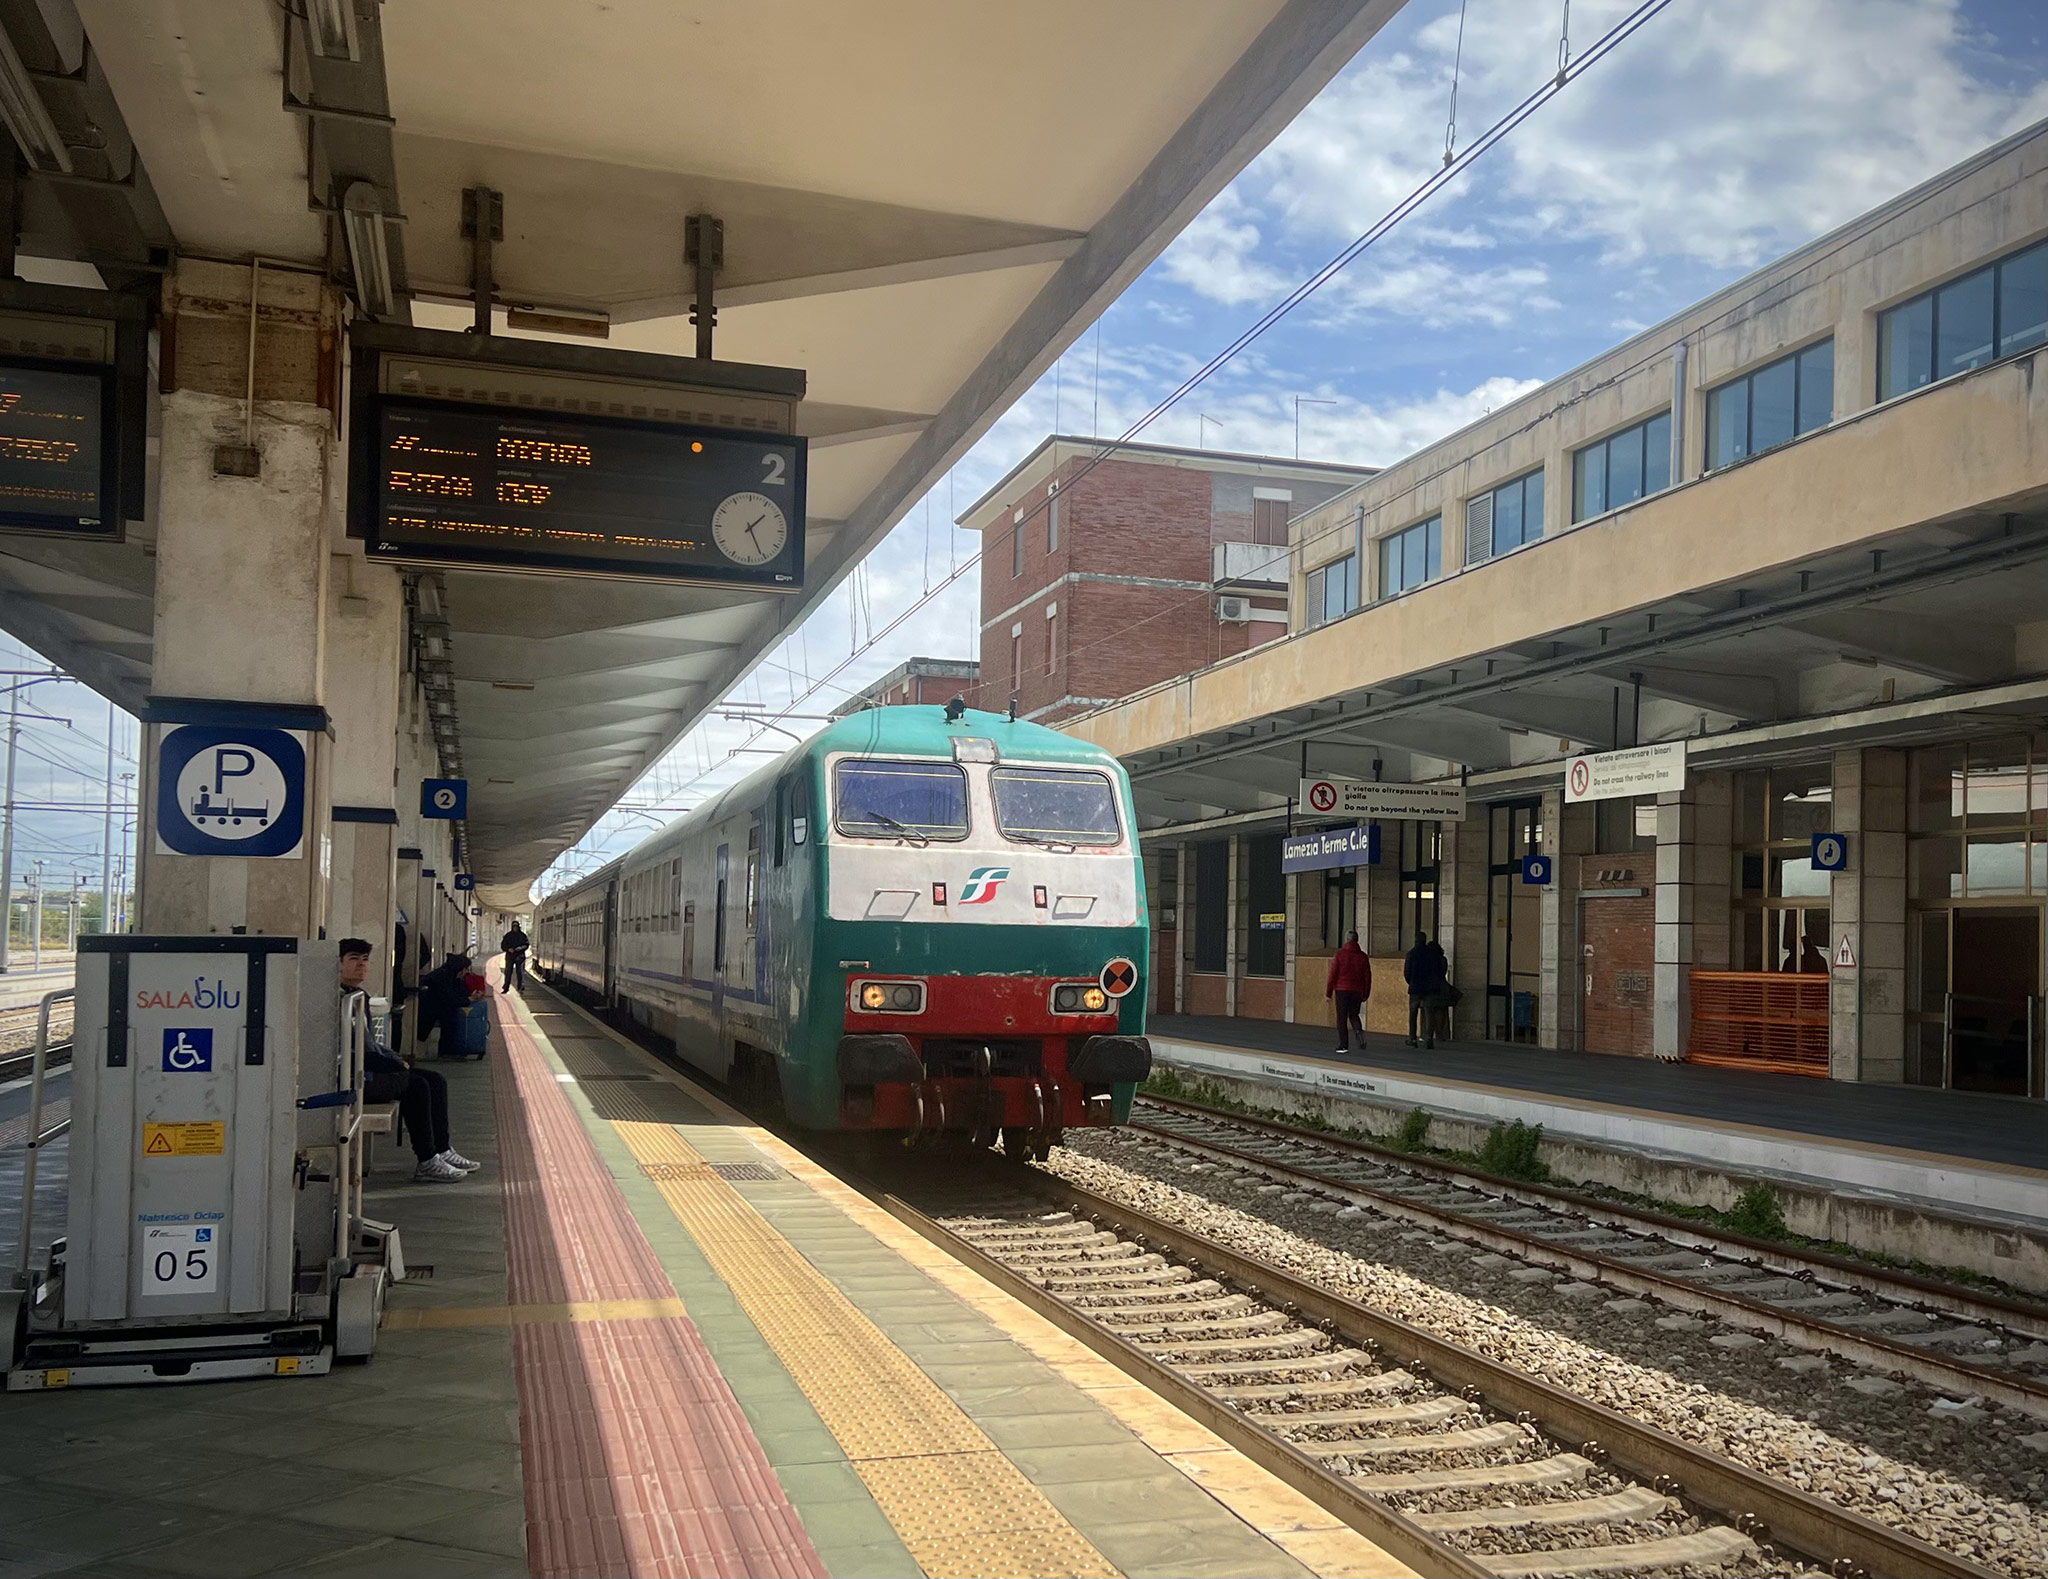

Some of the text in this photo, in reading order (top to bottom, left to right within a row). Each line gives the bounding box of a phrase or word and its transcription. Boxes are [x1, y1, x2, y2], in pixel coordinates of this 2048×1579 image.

[761, 452, 786, 486] 2
[214, 748, 255, 794] P
[1593, 778, 1601, 786] Do
[1602, 777, 1611, 785] not
[1624, 774, 1634, 782] the
[1634, 772, 1655, 781] railway
[1352, 785, 1380, 793] vietato
[1381, 786, 1429, 796] oltrepassare
[1440, 789, 1459, 797] linea
[440, 792, 450, 806] 2
[1344, 803, 1355, 811] Do
[1370, 805, 1380, 813] go
[1380, 805, 1408, 814] beyond
[1421, 807, 1445, 815] yellow
[1284, 827, 1368, 860] Lamezia Terme C.le
[137, 1213, 190, 1222] Nabtesco
[154, 1248, 208, 1282] 05
